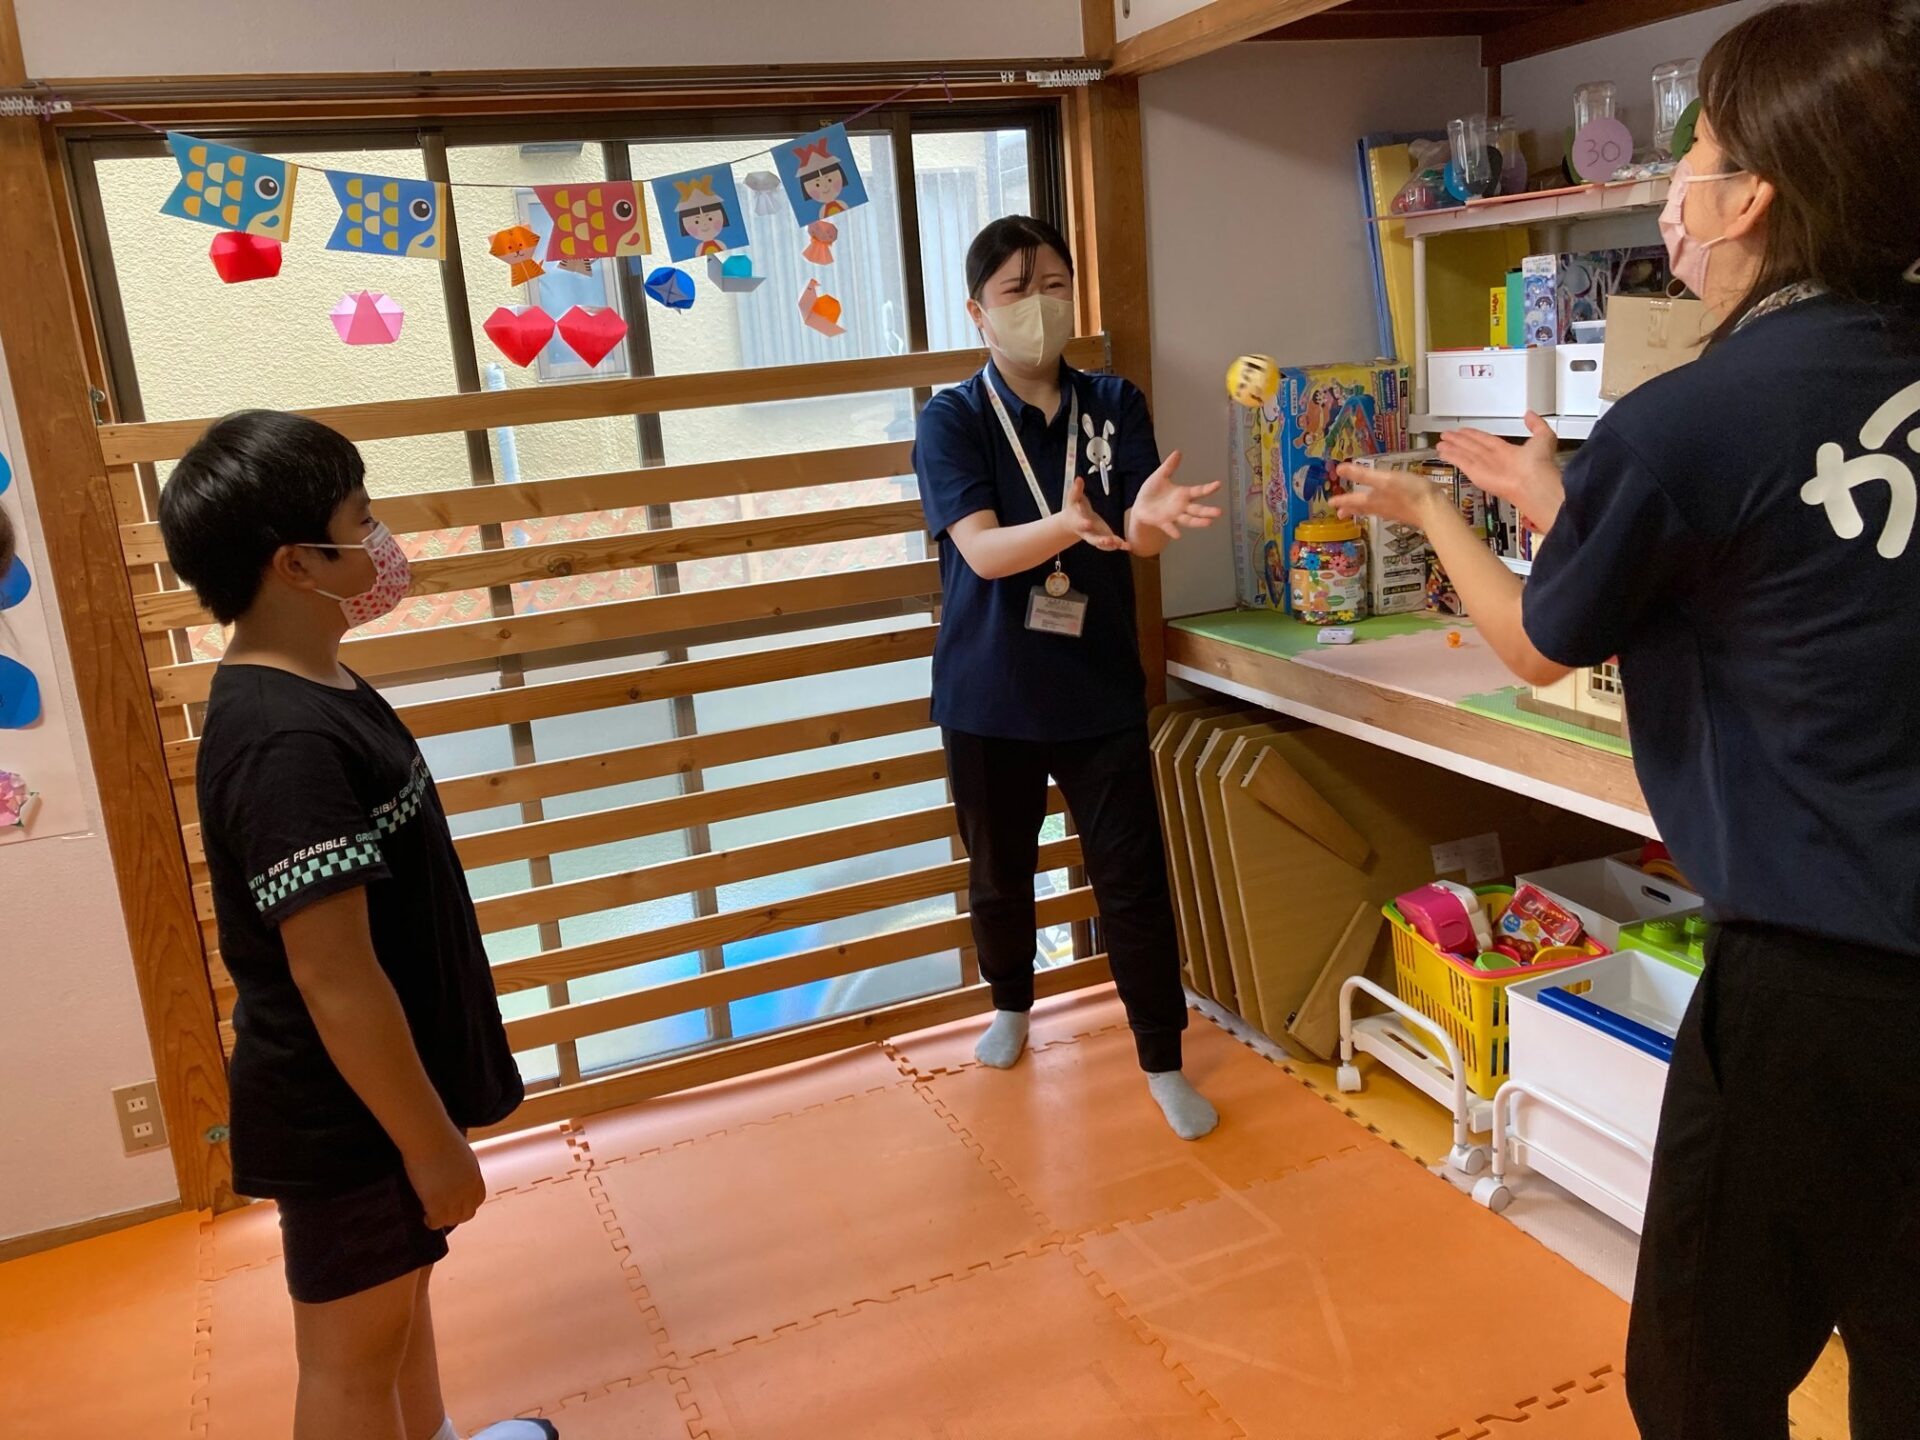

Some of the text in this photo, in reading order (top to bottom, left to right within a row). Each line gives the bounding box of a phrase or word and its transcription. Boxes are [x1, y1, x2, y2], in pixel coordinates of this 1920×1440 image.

[1584, 139, 1621, 167] 30
[370, 797, 398, 818] SIBLE
[268, 858, 290, 877] RATE
[293, 836, 348, 863] FEASIBLE
